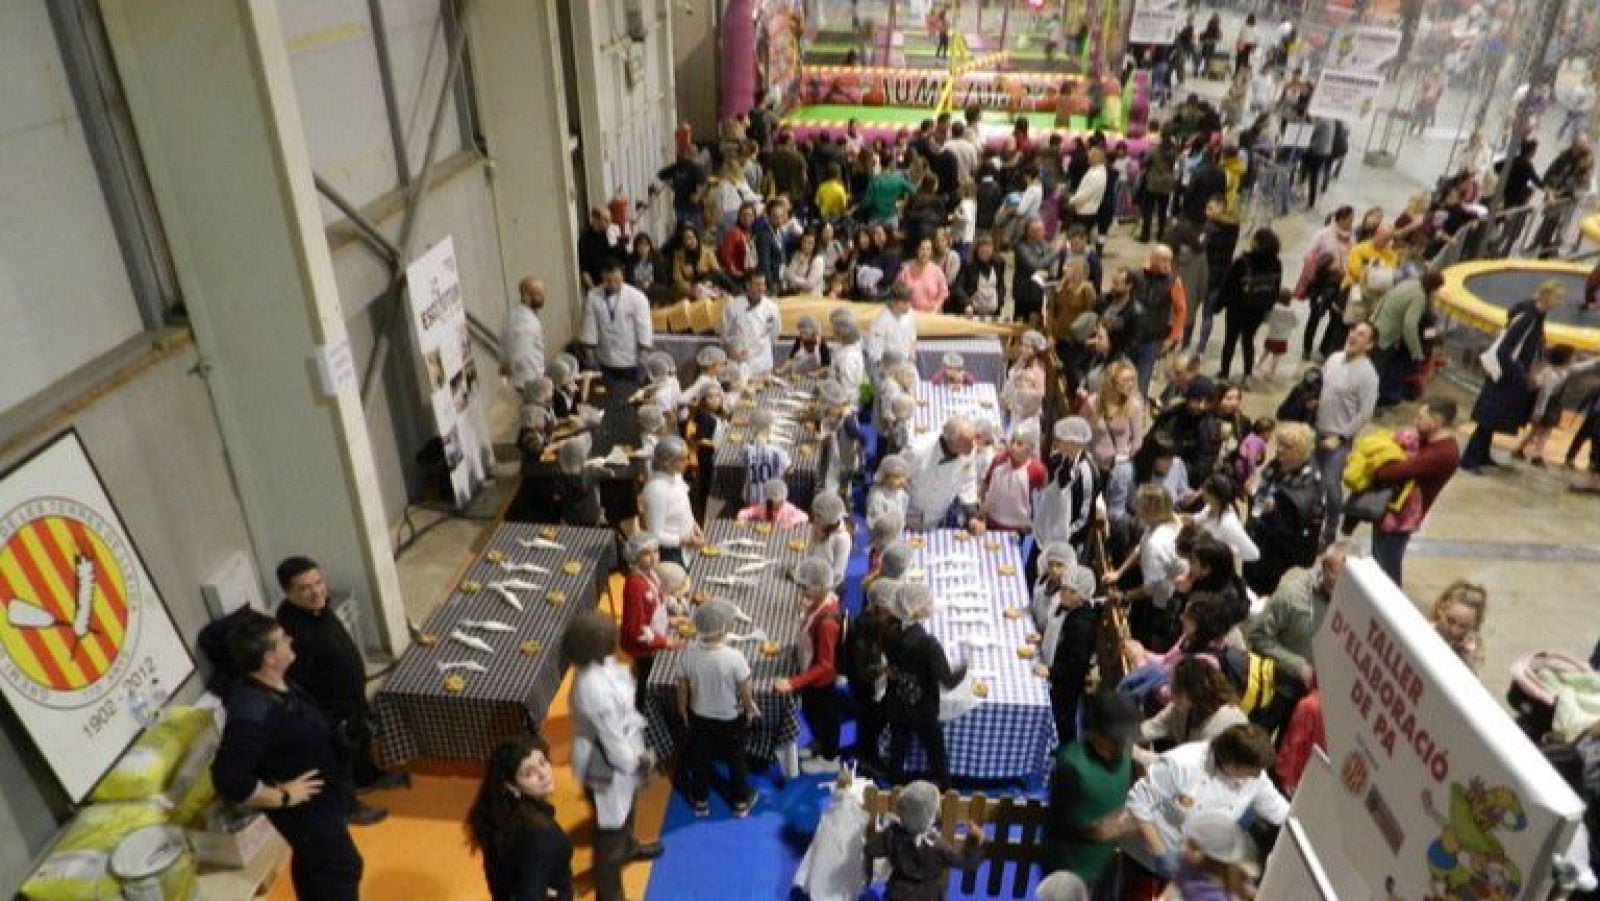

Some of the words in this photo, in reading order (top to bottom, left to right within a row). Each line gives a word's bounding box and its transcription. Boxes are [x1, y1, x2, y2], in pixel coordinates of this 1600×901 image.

[1331, 610, 1448, 783] D'ELABORACIÓ
[1367, 617, 1424, 706] TALLER
[83, 699, 118, 736] 1902
[1352, 677, 1373, 721] DE
[1374, 713, 1396, 758] PA
